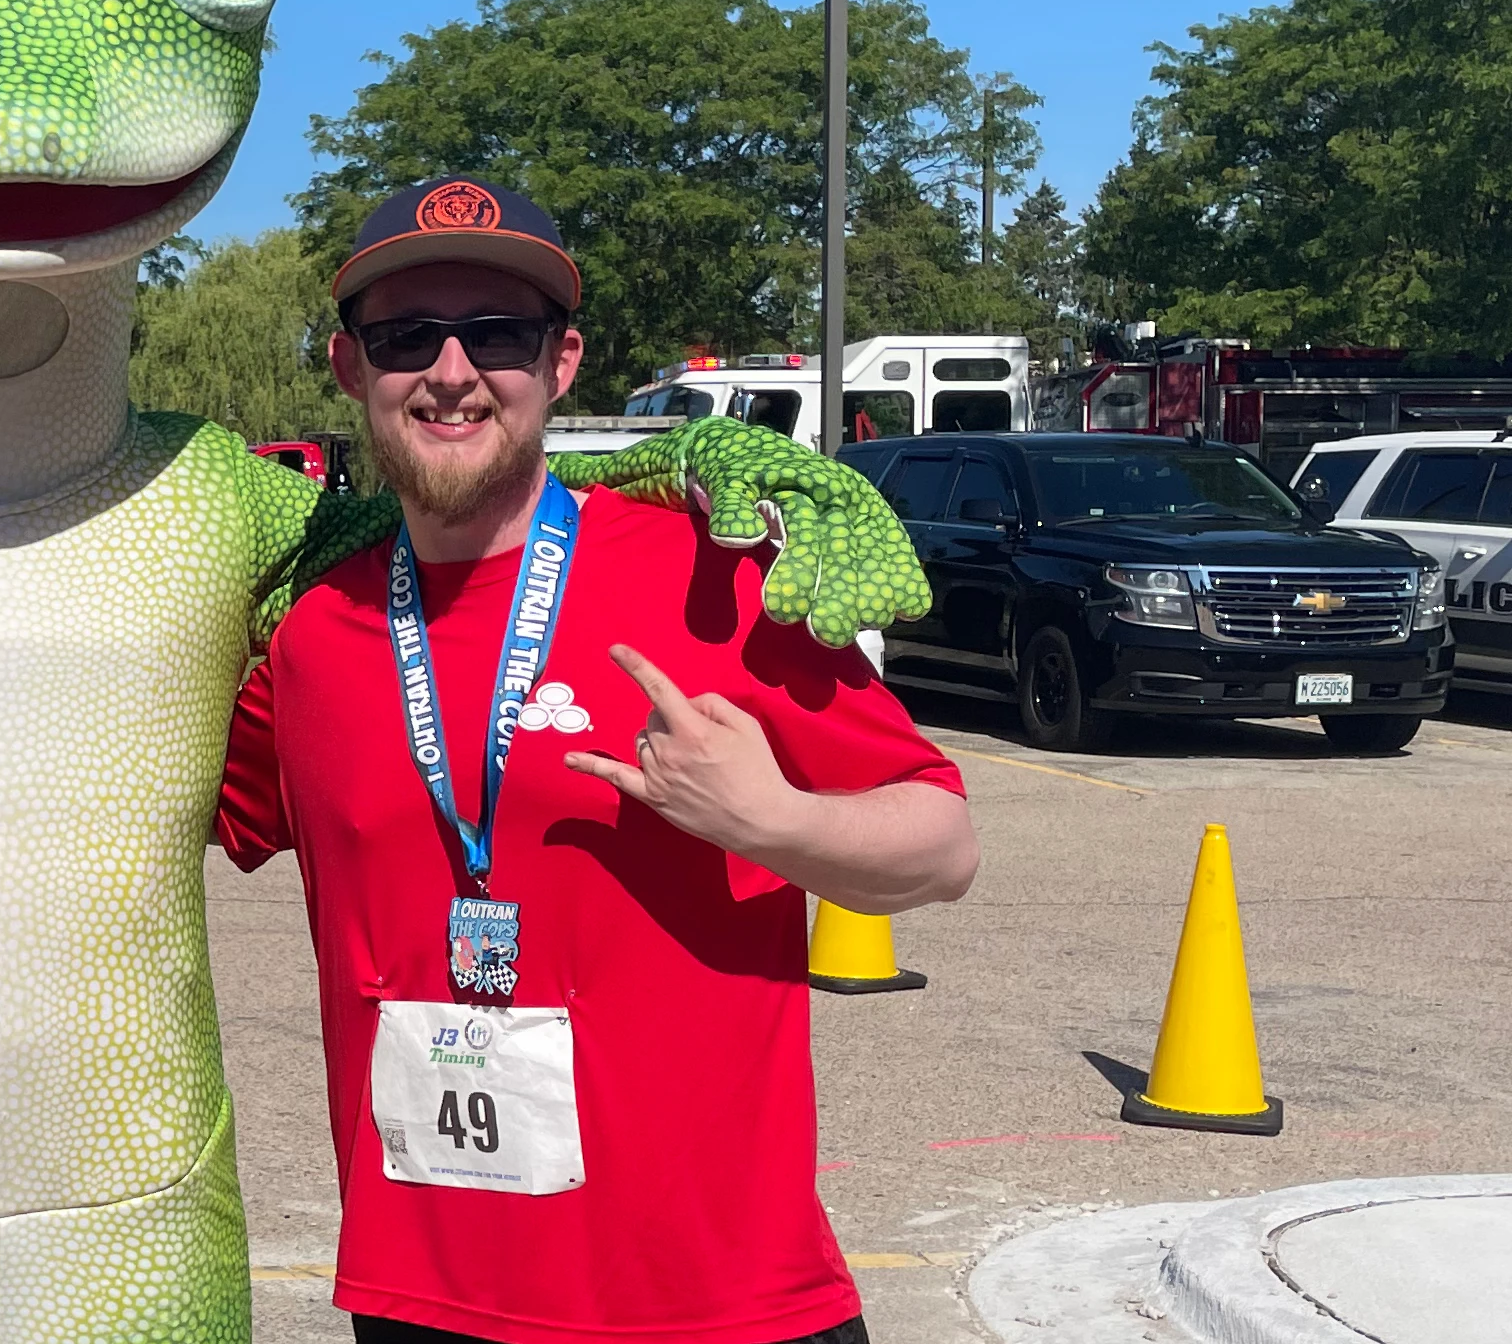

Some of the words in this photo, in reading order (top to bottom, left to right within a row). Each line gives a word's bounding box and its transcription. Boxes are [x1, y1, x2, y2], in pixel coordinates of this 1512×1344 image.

[540, 522, 569, 540] I
[390, 546, 413, 609] COPS
[515, 540, 566, 641] OUTRAN
[393, 612, 424, 662] THE
[503, 646, 540, 695] THE
[1310, 681, 1349, 696] 225056
[403, 664, 441, 765] OUTRAN
[427, 771, 445, 783] I
[452, 901, 459, 917] I
[461, 901, 515, 920] OUTRAN
[452, 920, 476, 937] THE
[479, 921, 516, 938] COPS
[432, 1027, 459, 1046] J3
[429, 1047, 486, 1068] Timing
[438, 1089, 499, 1153] 49
